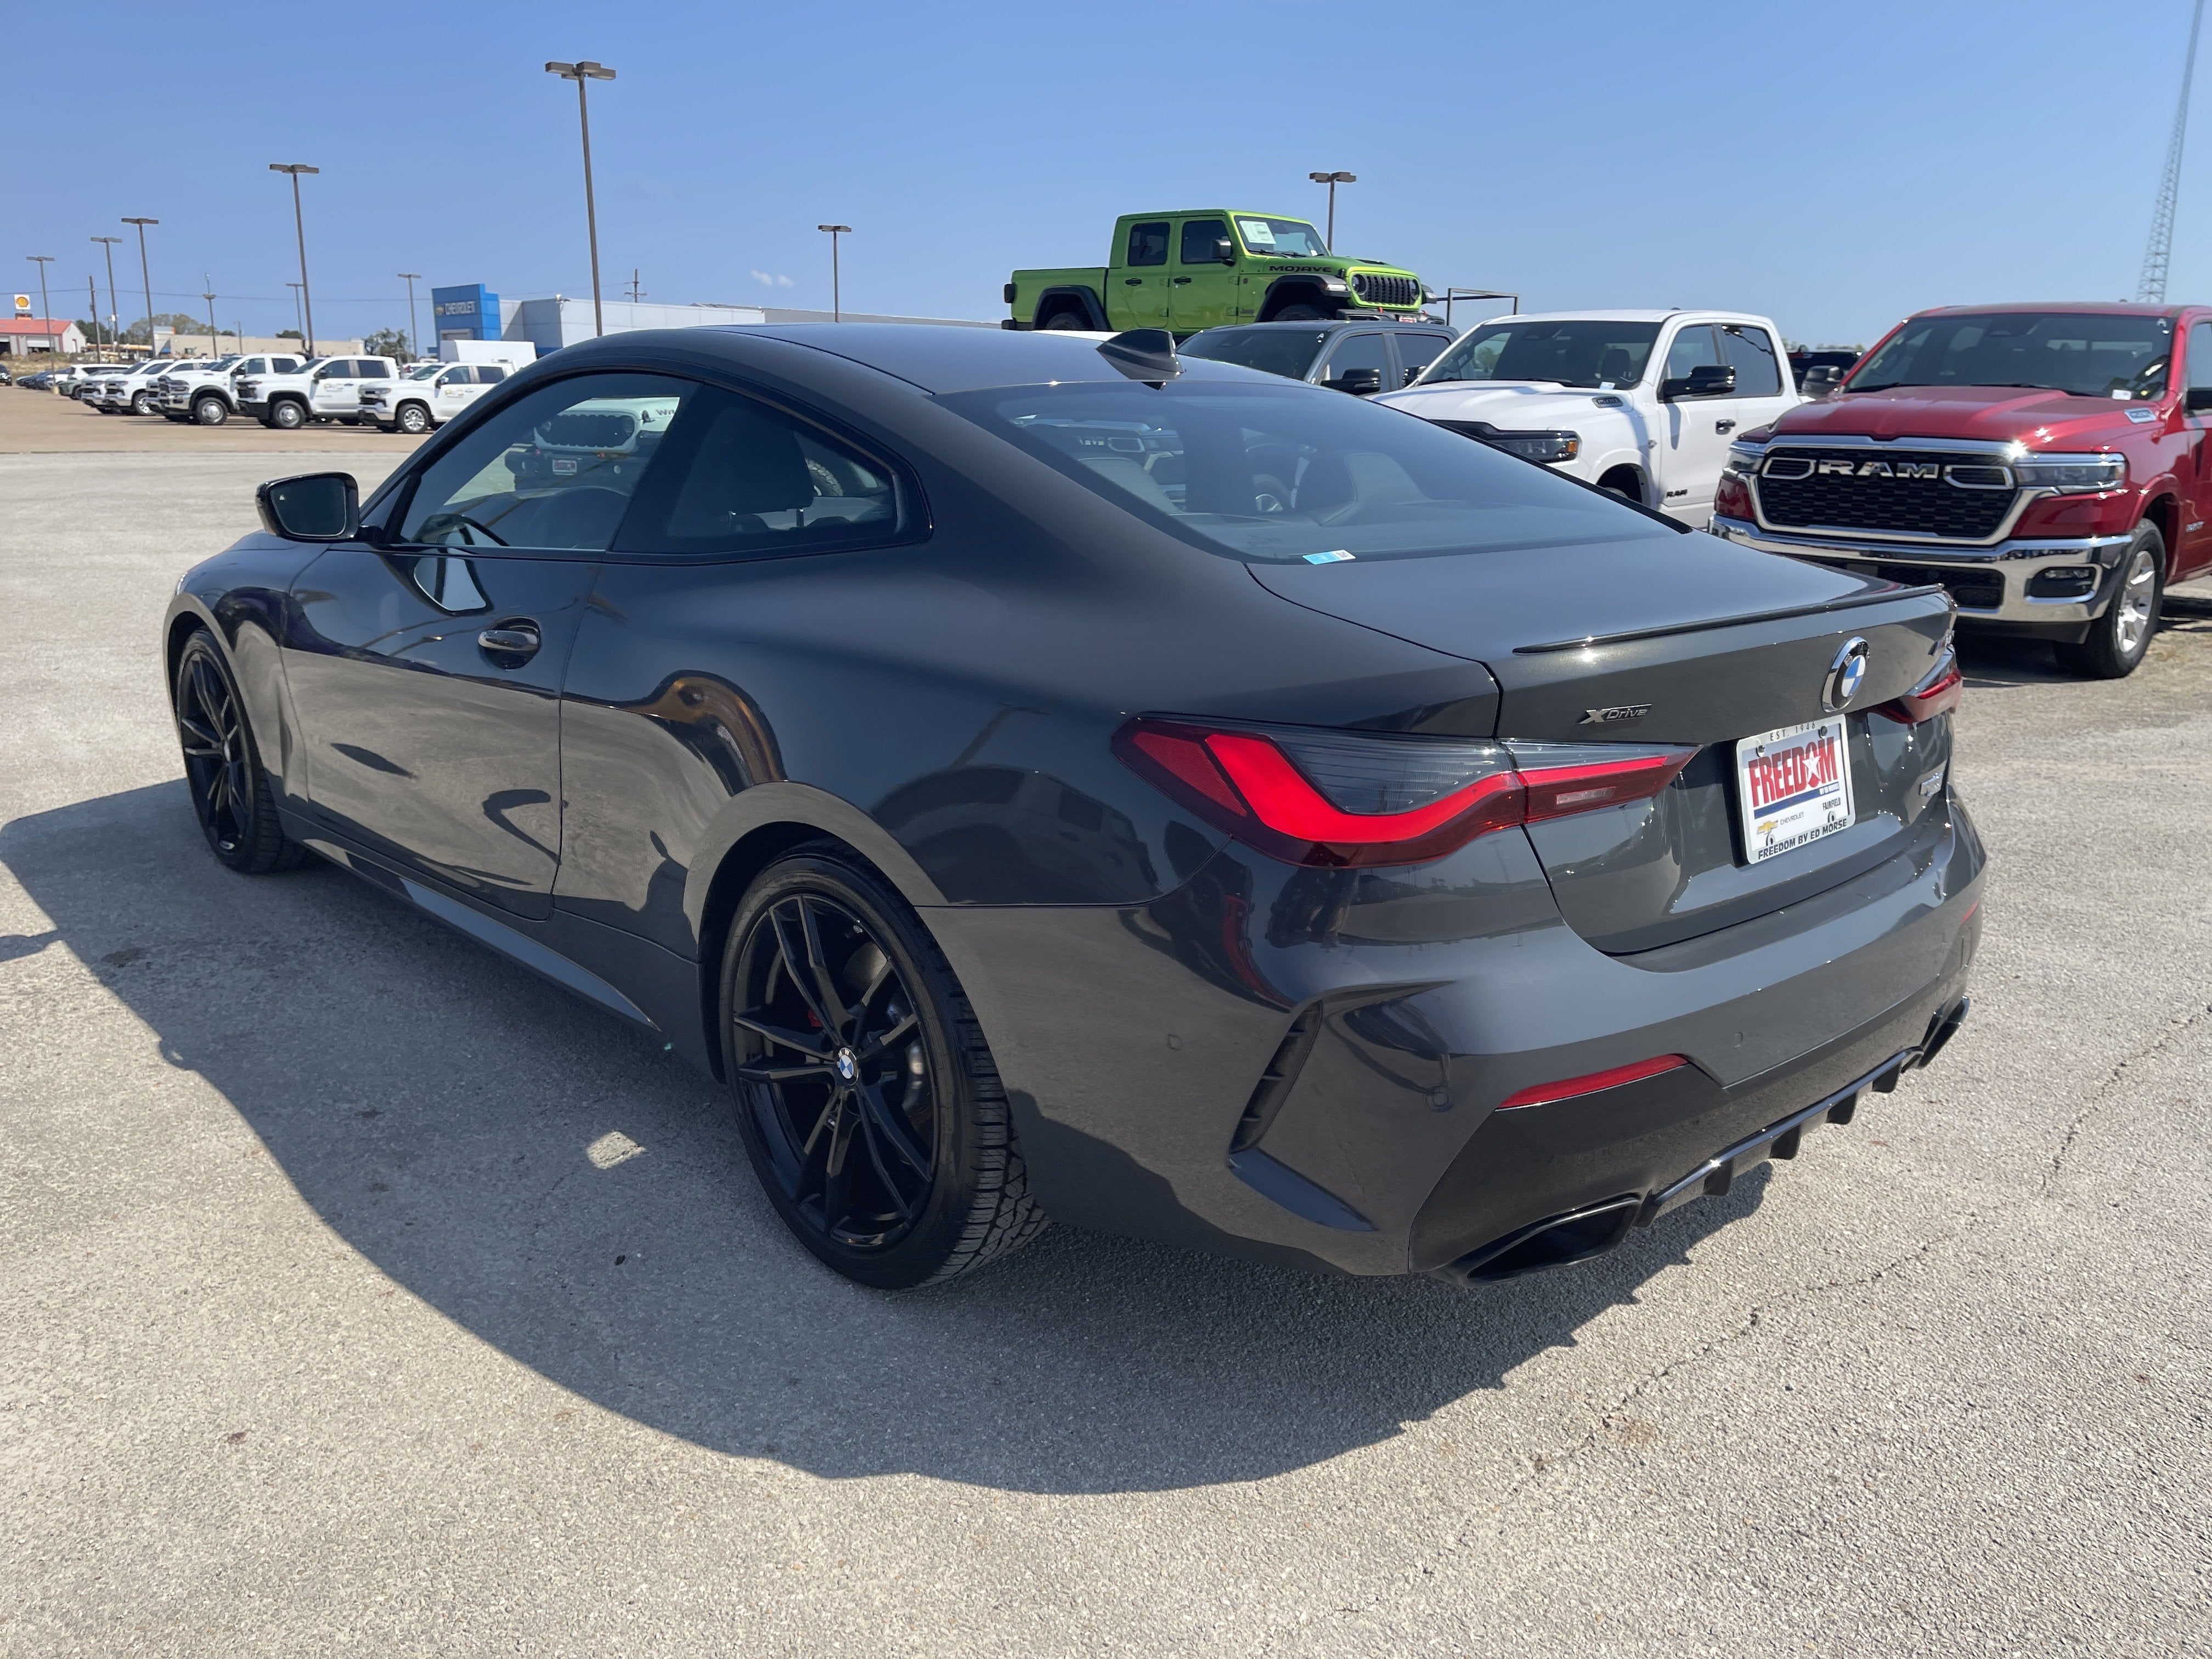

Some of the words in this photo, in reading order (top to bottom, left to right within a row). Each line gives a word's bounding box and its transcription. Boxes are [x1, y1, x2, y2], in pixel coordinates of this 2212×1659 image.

[1818, 459, 1939, 479] RAM
[1770, 730, 1790, 742] EST.
[1795, 721, 1816, 735] 1946
[1748, 737, 1838, 808] FREEDOM
[1822, 797, 1841, 811] FAIRFIELD
[1780, 811, 1804, 825] CHEVROLET
[1758, 839, 1796, 860] FREEDOM
[1798, 833, 1808, 845] BY
[1810, 828, 1820, 841] ED
[1822, 818, 1847, 836] MORSE
